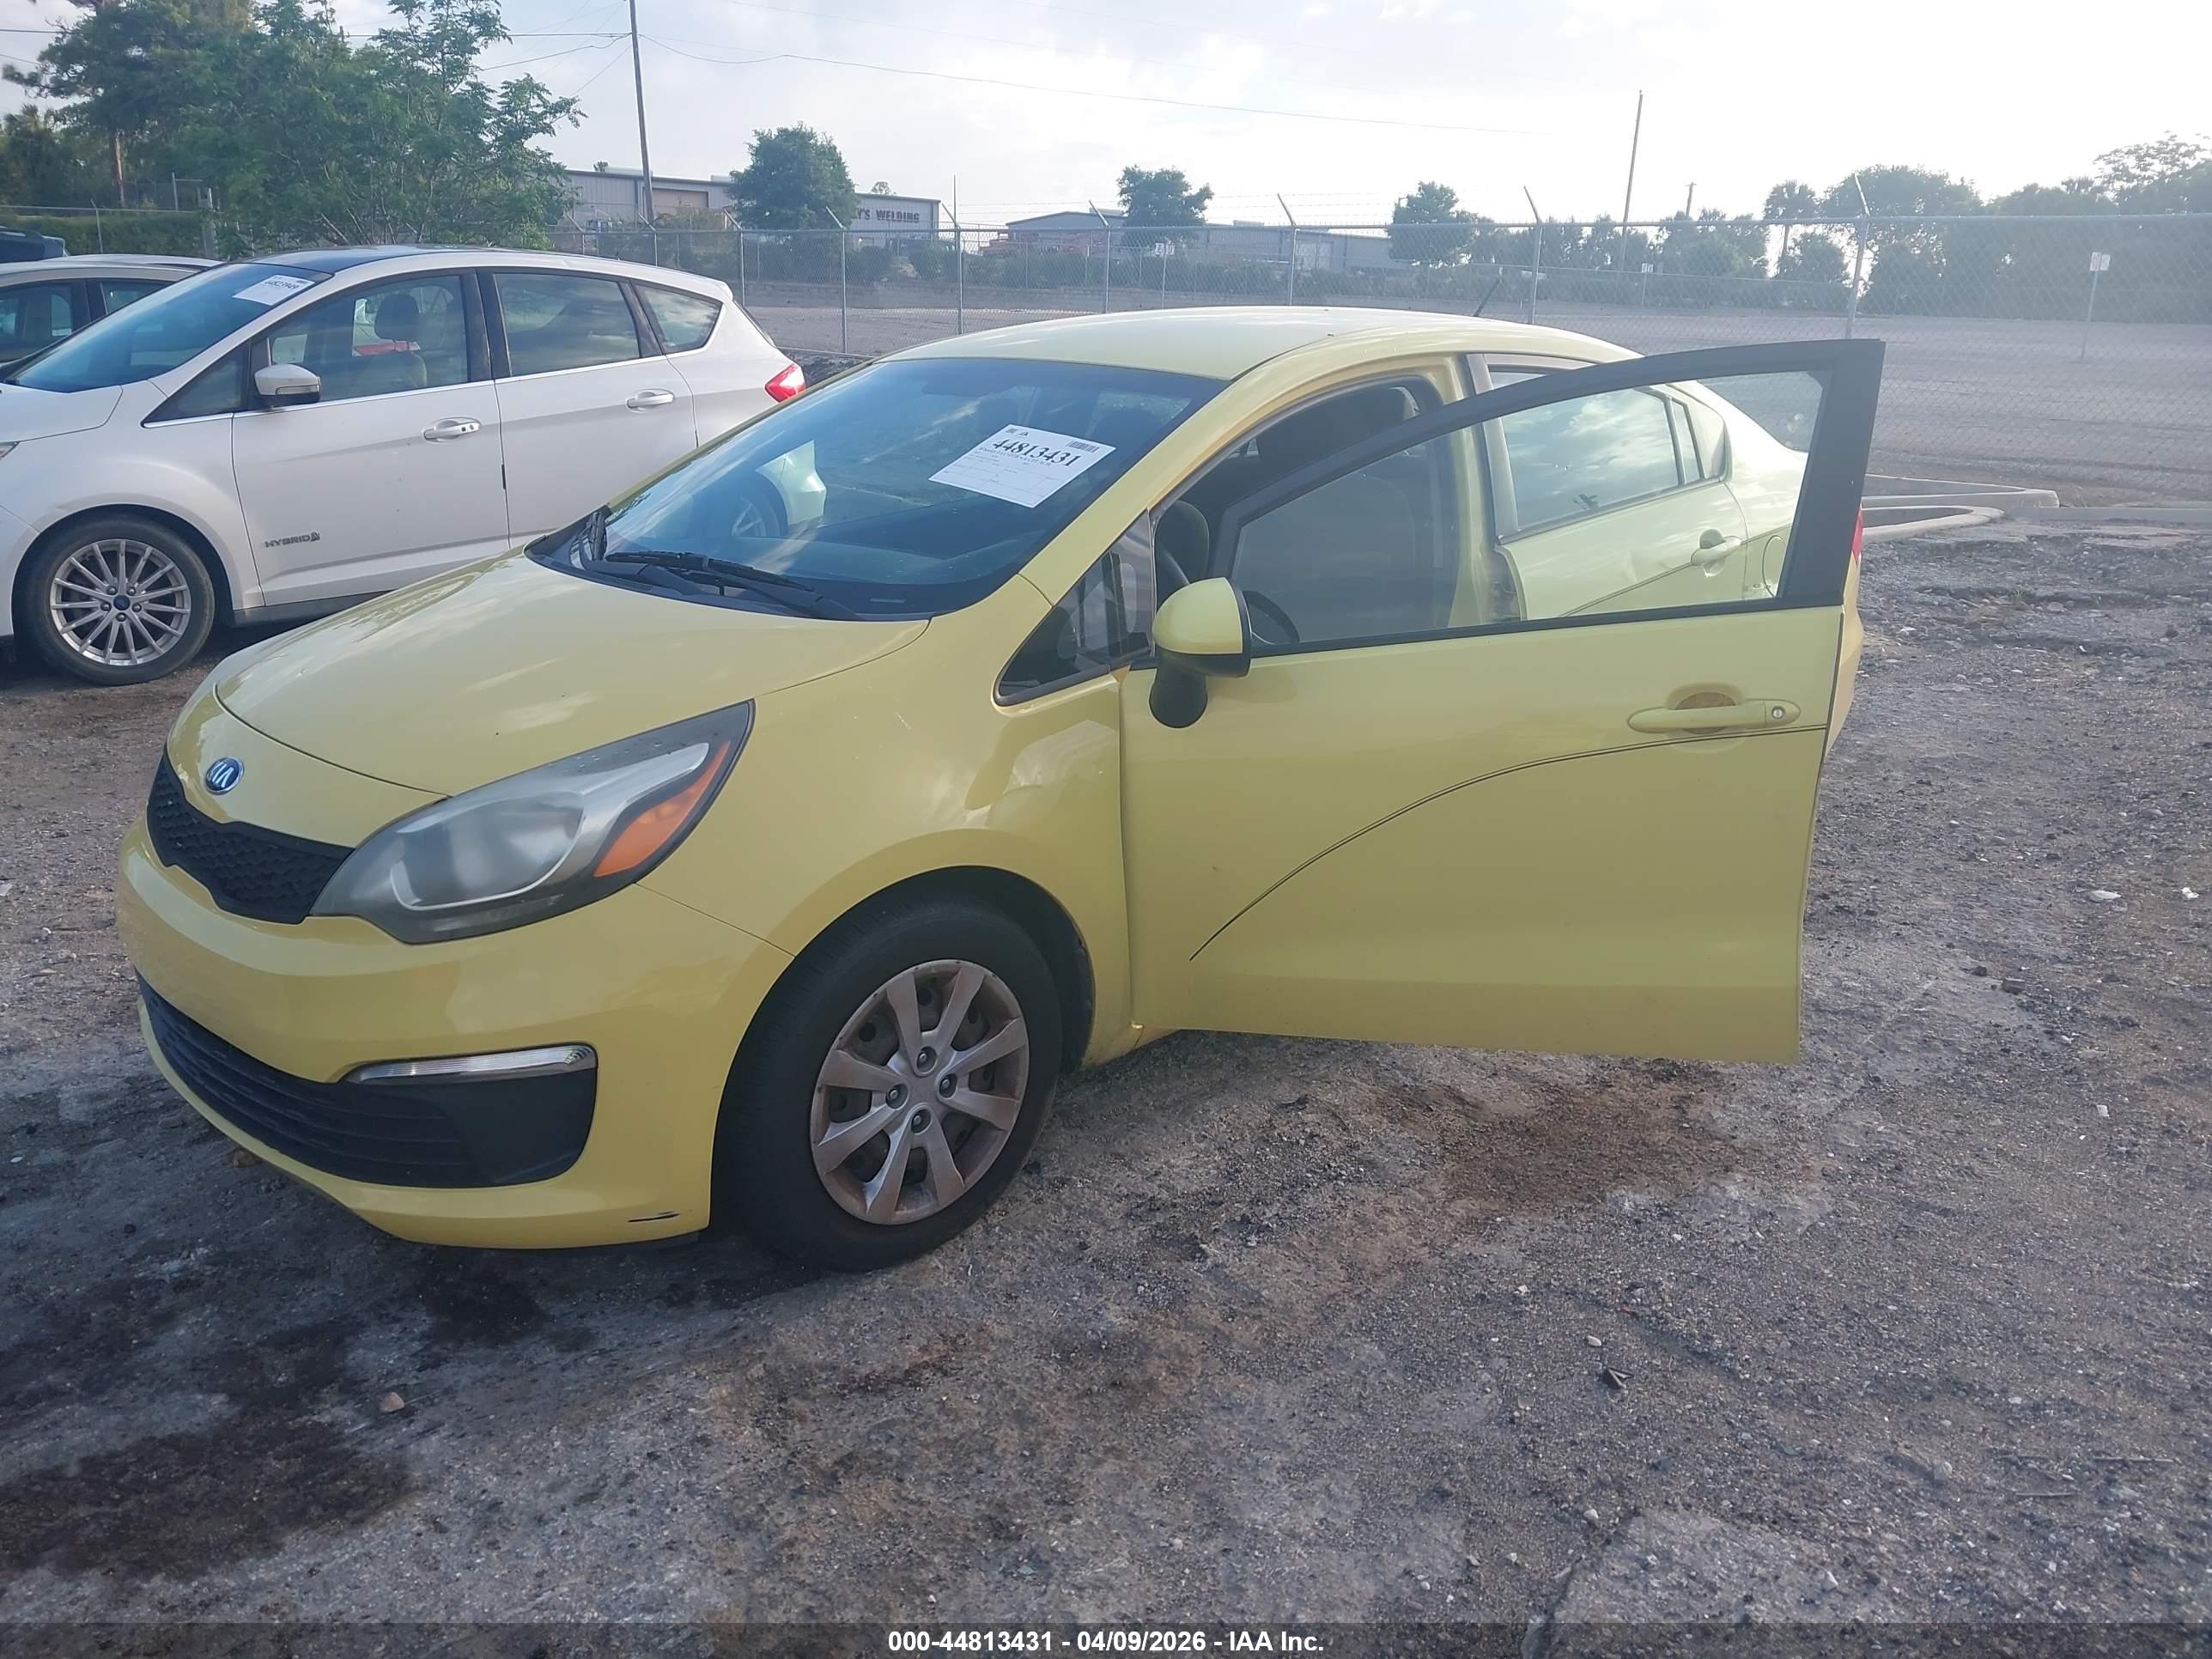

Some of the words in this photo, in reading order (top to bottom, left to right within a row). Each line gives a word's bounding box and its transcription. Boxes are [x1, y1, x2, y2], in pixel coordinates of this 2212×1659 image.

[876, 210, 920, 222] WELDING
[993, 440, 1081, 466] 44813431
[264, 535, 311, 548] HYBRID
